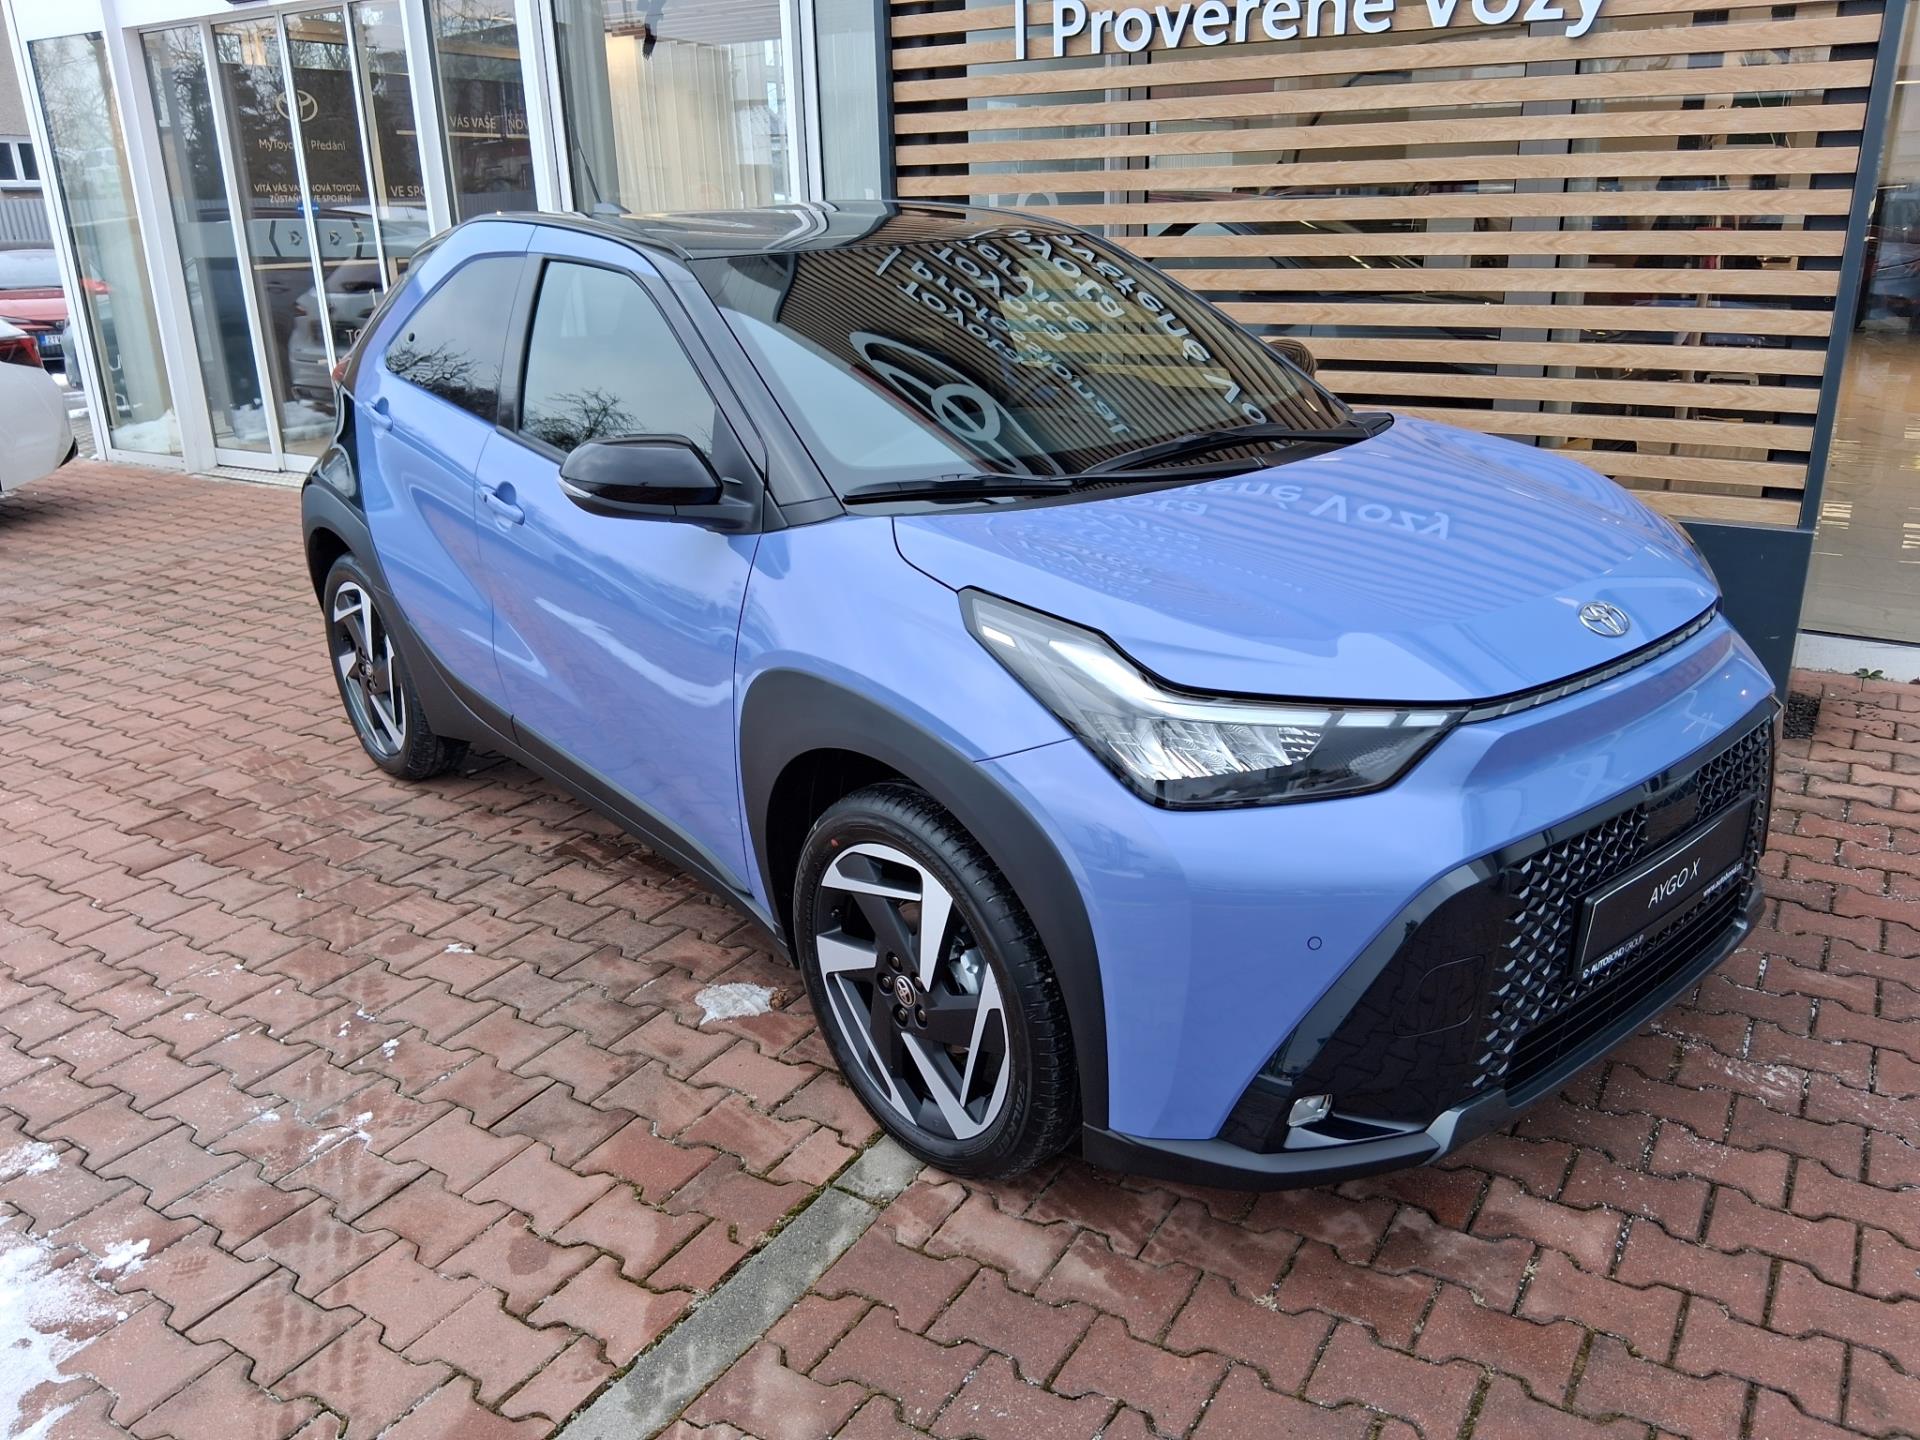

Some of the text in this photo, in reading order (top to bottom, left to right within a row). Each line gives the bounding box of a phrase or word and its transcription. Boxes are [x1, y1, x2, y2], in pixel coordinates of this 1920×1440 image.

[310, 139, 346, 151] Předání
[332, 184, 361, 192] TOYOTA
[390, 185, 404, 197] VE
[1647, 857, 1701, 909] AYGO X
[1590, 934, 1645, 975] AUTOBOND GROUP
